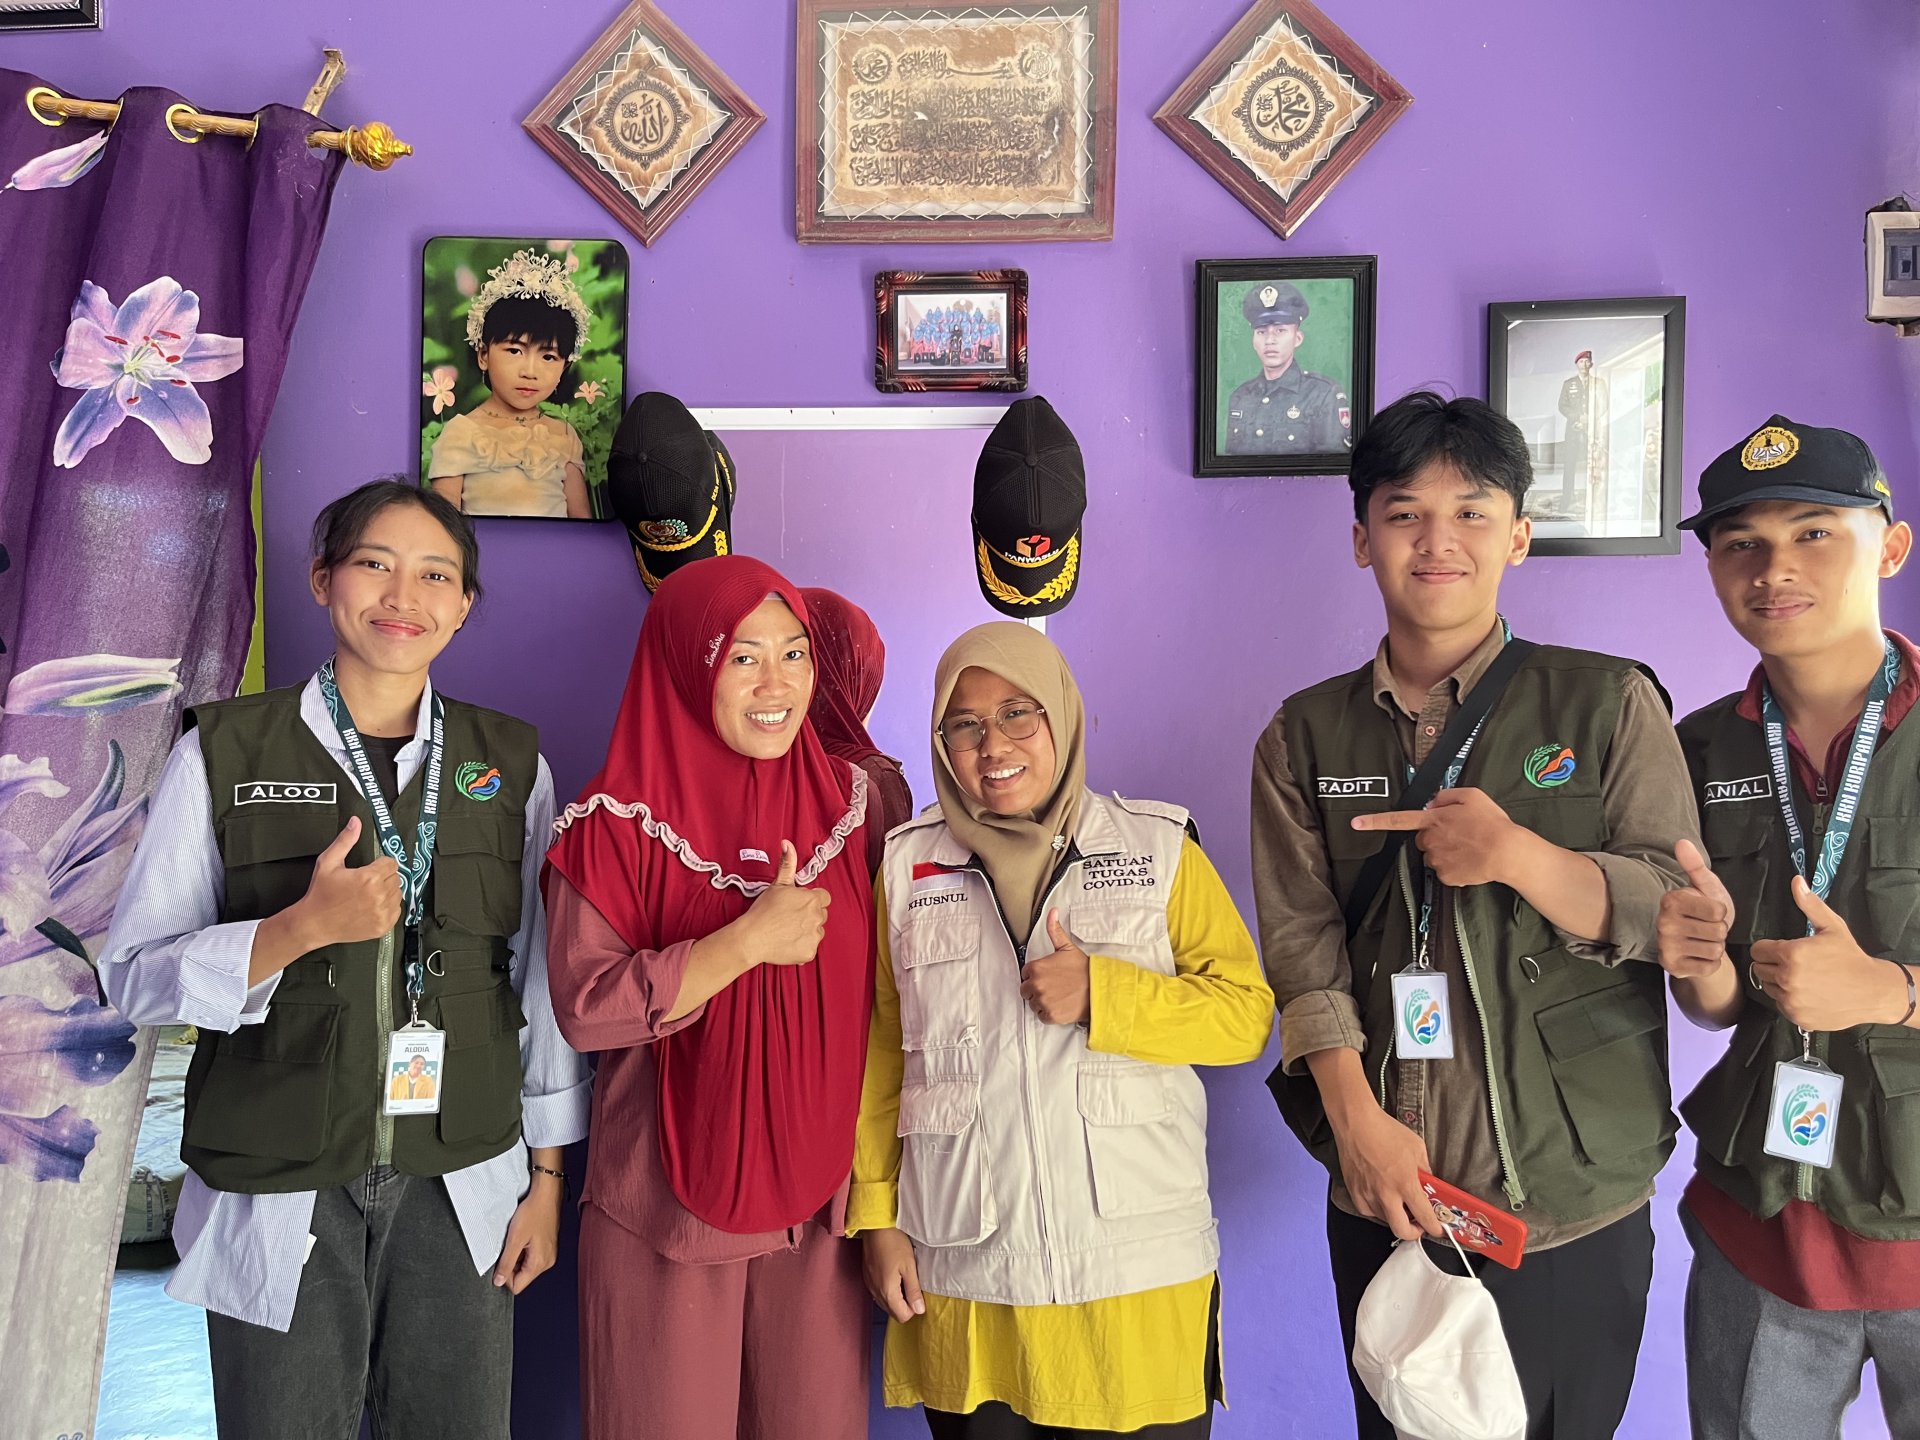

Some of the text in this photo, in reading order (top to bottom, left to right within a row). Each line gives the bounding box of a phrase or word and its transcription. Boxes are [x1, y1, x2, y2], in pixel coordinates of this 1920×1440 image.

[423, 717, 444, 815] KKN KURIPAN KIDUL
[1835, 699, 1885, 824] KKN KURIPAN KIDUL
[342, 727, 393, 832] KKN KURIPAN KIDUL
[1318, 780, 1374, 794] RADIT
[1766, 722, 1802, 844] KKN KURIPAN KIDUL
[250, 785, 321, 799] ALOO
[1705, 781, 1764, 800] ANIAL
[1082, 855, 1153, 870] SATUAN
[1088, 867, 1148, 879] TUGAS
[1083, 877, 1156, 891] COVID-19
[907, 893, 968, 911] KHUSNUL
